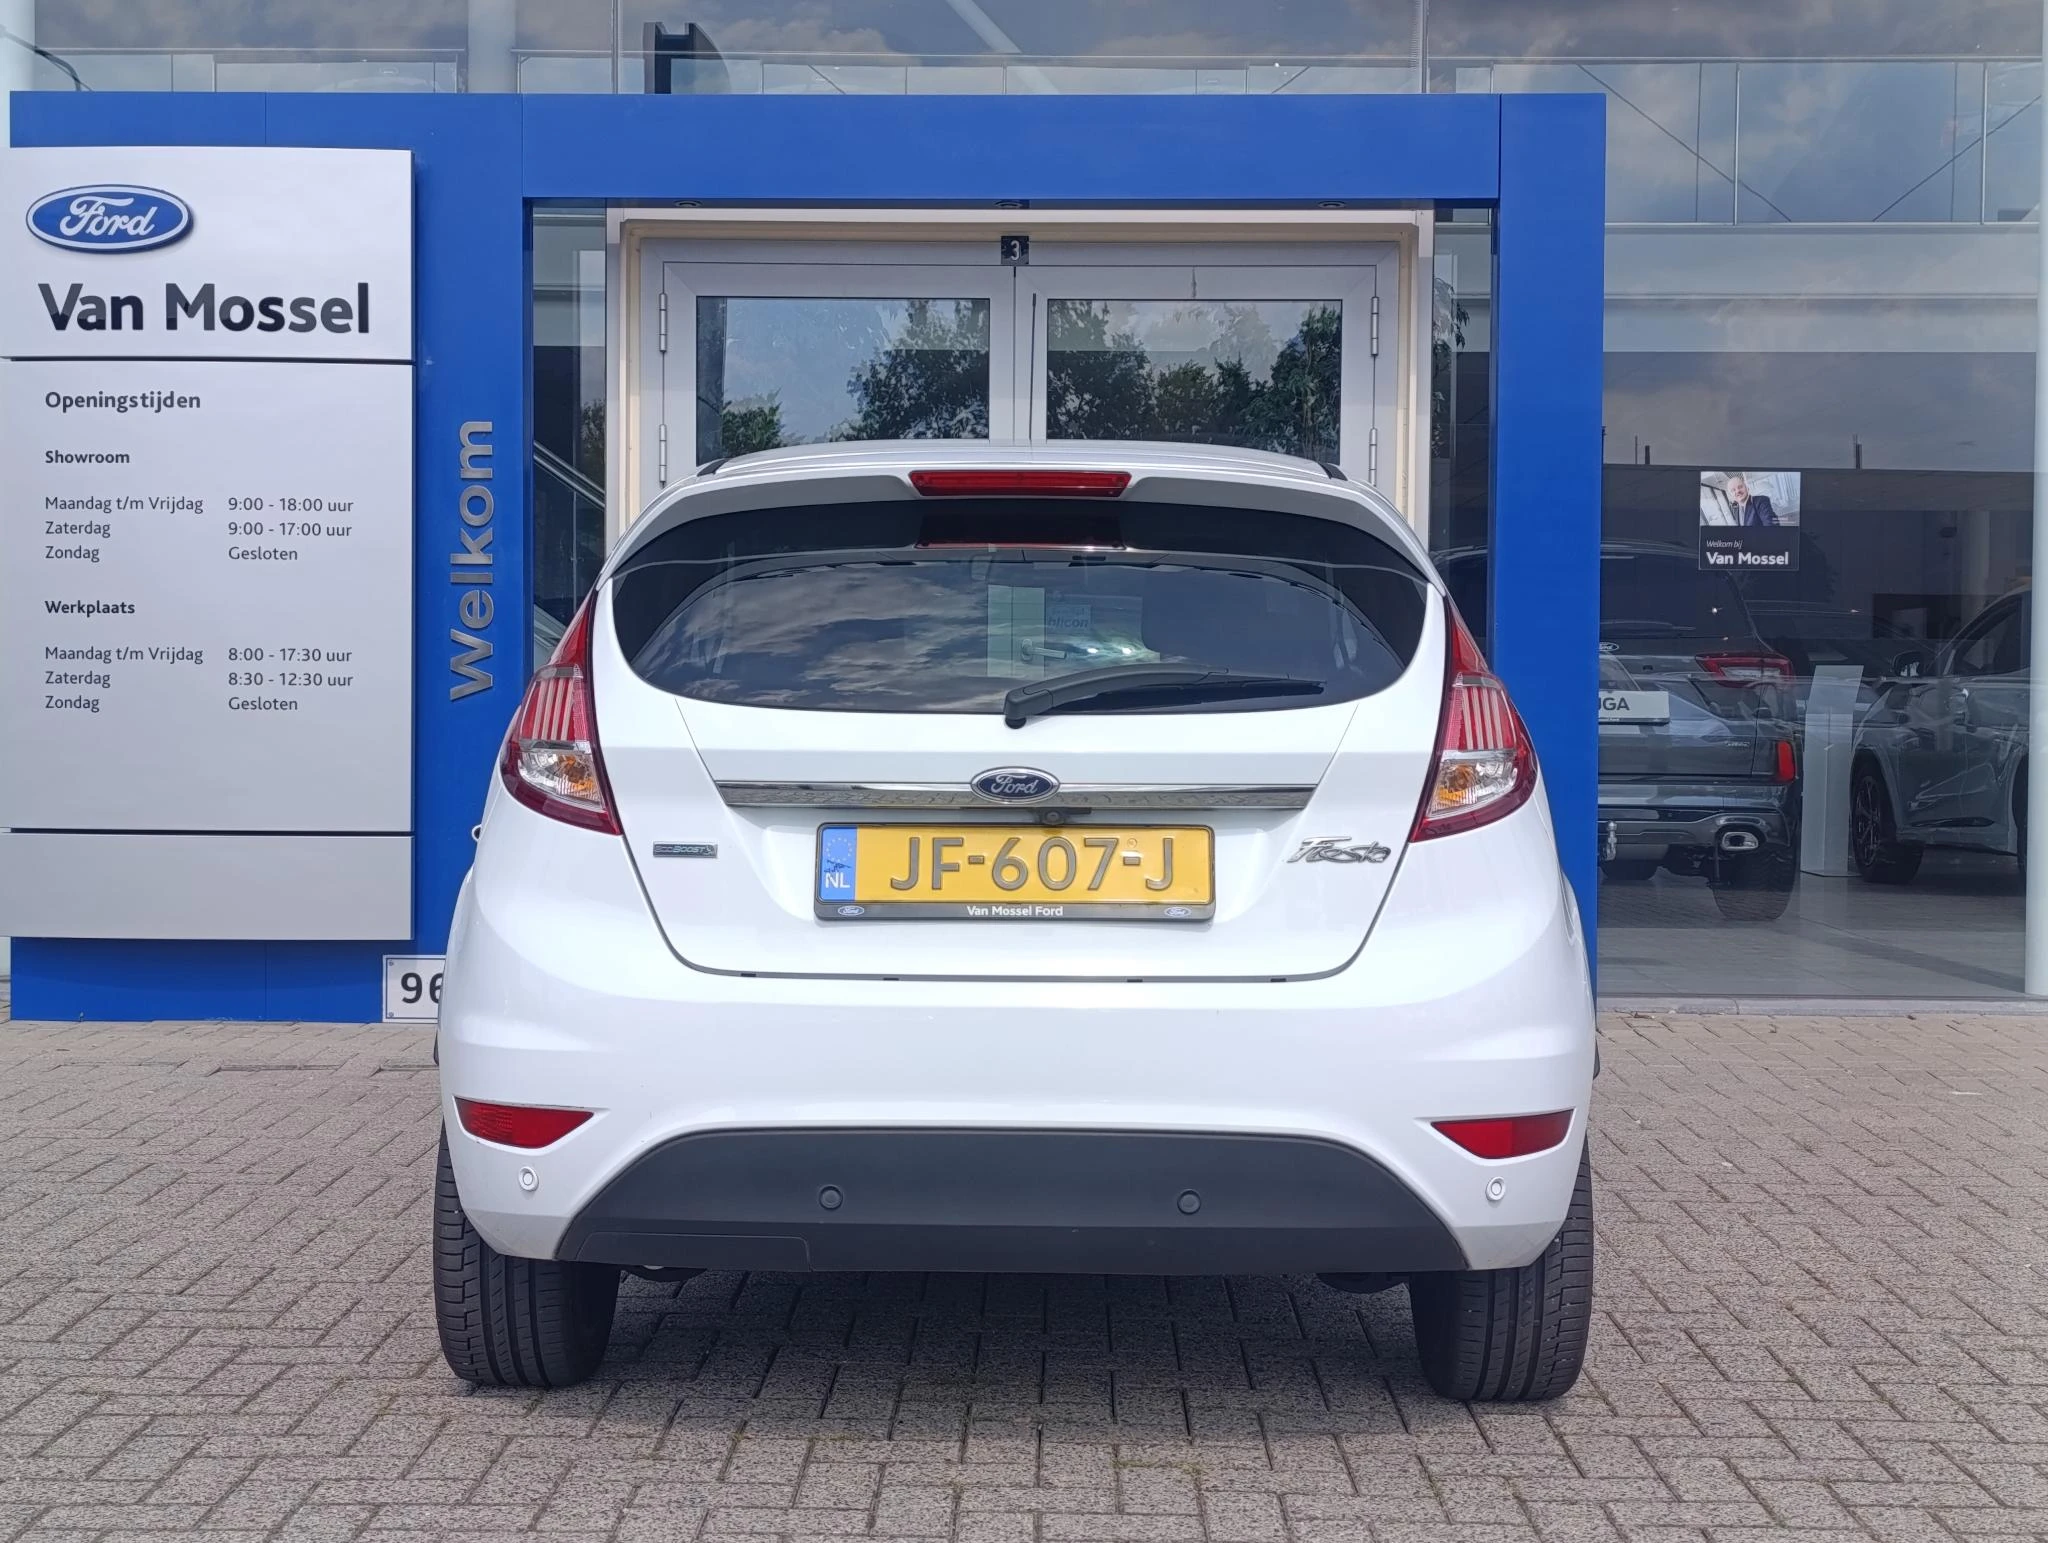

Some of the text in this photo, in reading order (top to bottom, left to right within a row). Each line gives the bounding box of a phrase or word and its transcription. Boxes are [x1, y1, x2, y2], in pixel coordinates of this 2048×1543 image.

[59, 195, 158, 238] Ford
[1009, 239, 1021, 262] 3
[38, 282, 370, 333] Van Mossel
[45, 391, 201, 413] Openingstijden
[45, 449, 130, 464] Showroom
[45, 496, 204, 514] Maandag t/m Vrijdag
[228, 497, 264, 511] 9:00
[280, 498, 323, 512] 18:00
[328, 502, 354, 512] uur
[45, 520, 111, 538] Zaterdag
[228, 522, 264, 536] 9:00
[280, 522, 322, 536] 17:00
[327, 527, 353, 537] uur
[1706, 540, 1733, 548] Welkom
[45, 544, 101, 563] Zondag
[228, 546, 298, 561] Gesloten
[450, 420, 495, 701] Welkom
[1706, 551, 1789, 565] Van Mossel
[45, 599, 136, 618] Werkplaats
[45, 646, 204, 664] Maandag t/m Vrijdag
[228, 648, 264, 662] 8:00
[280, 648, 322, 662] 17:30
[327, 652, 353, 662] uur
[45, 671, 111, 688] Zaterdag
[228, 672, 264, 686] 8:30
[280, 672, 323, 687] 12:30
[328, 677, 354, 687] uur
[45, 695, 100, 713] Zondag
[228, 696, 298, 711] Gesloten
[990, 774, 1039, 793] Ford
[1287, 836, 1392, 864] Fiesta
[825, 836, 1174, 891] NL JF-607-J
[966, 905, 1064, 916] Van Mossel Ford
